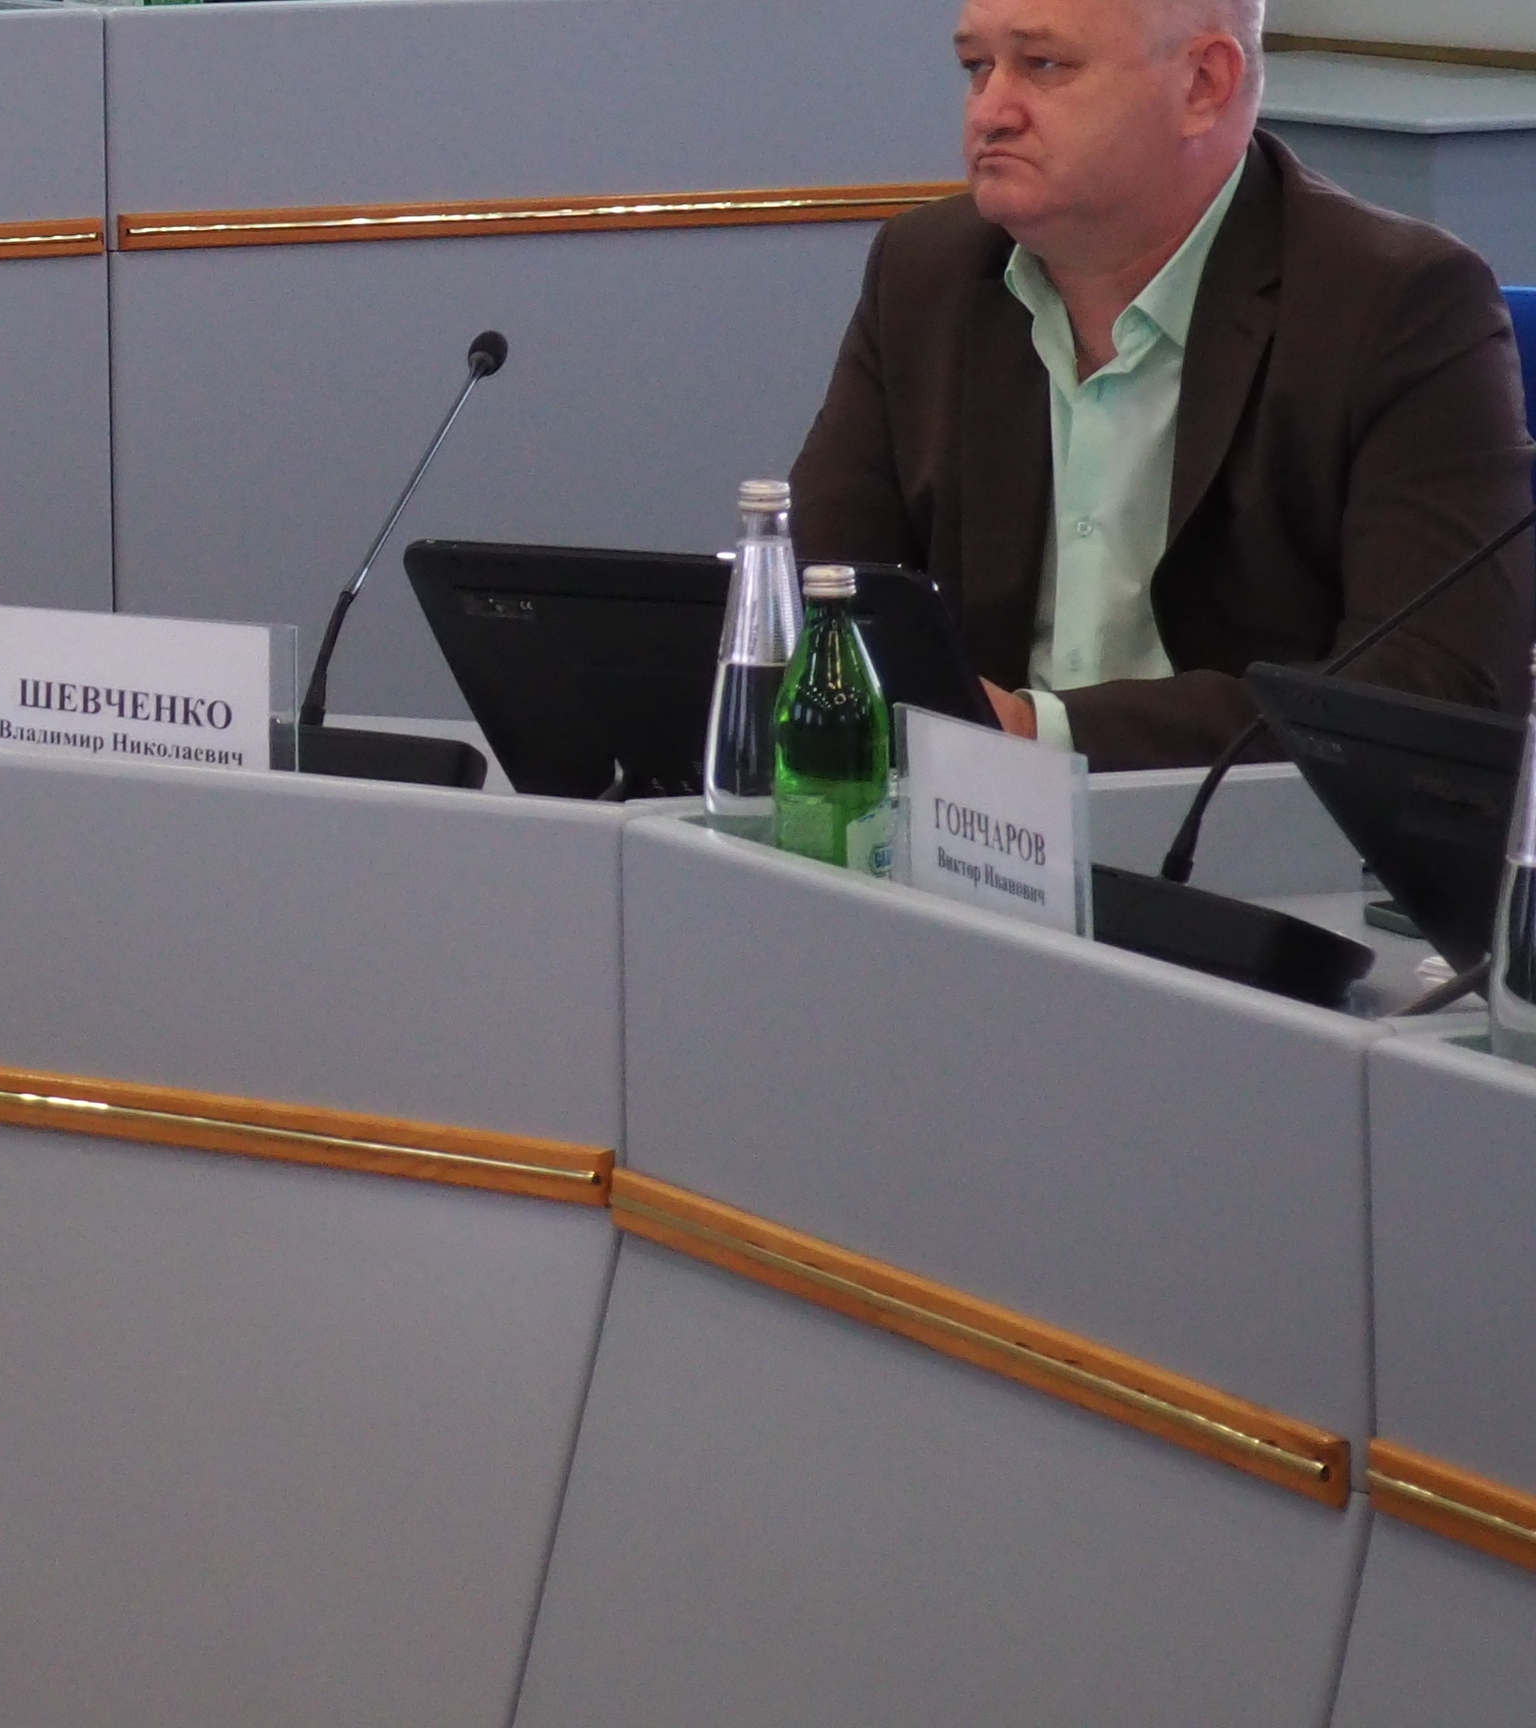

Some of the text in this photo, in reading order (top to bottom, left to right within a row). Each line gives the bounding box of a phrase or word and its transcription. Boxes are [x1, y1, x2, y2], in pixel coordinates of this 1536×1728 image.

[18, 678, 232, 729] ШЕВЧЕНКО
[112, 733, 244, 766] Николаевич
[934, 798, 1046, 865] ГОНЧАРОВ
[938, 846, 981, 887] Виктор
[985, 864, 1045, 905] Иванович
